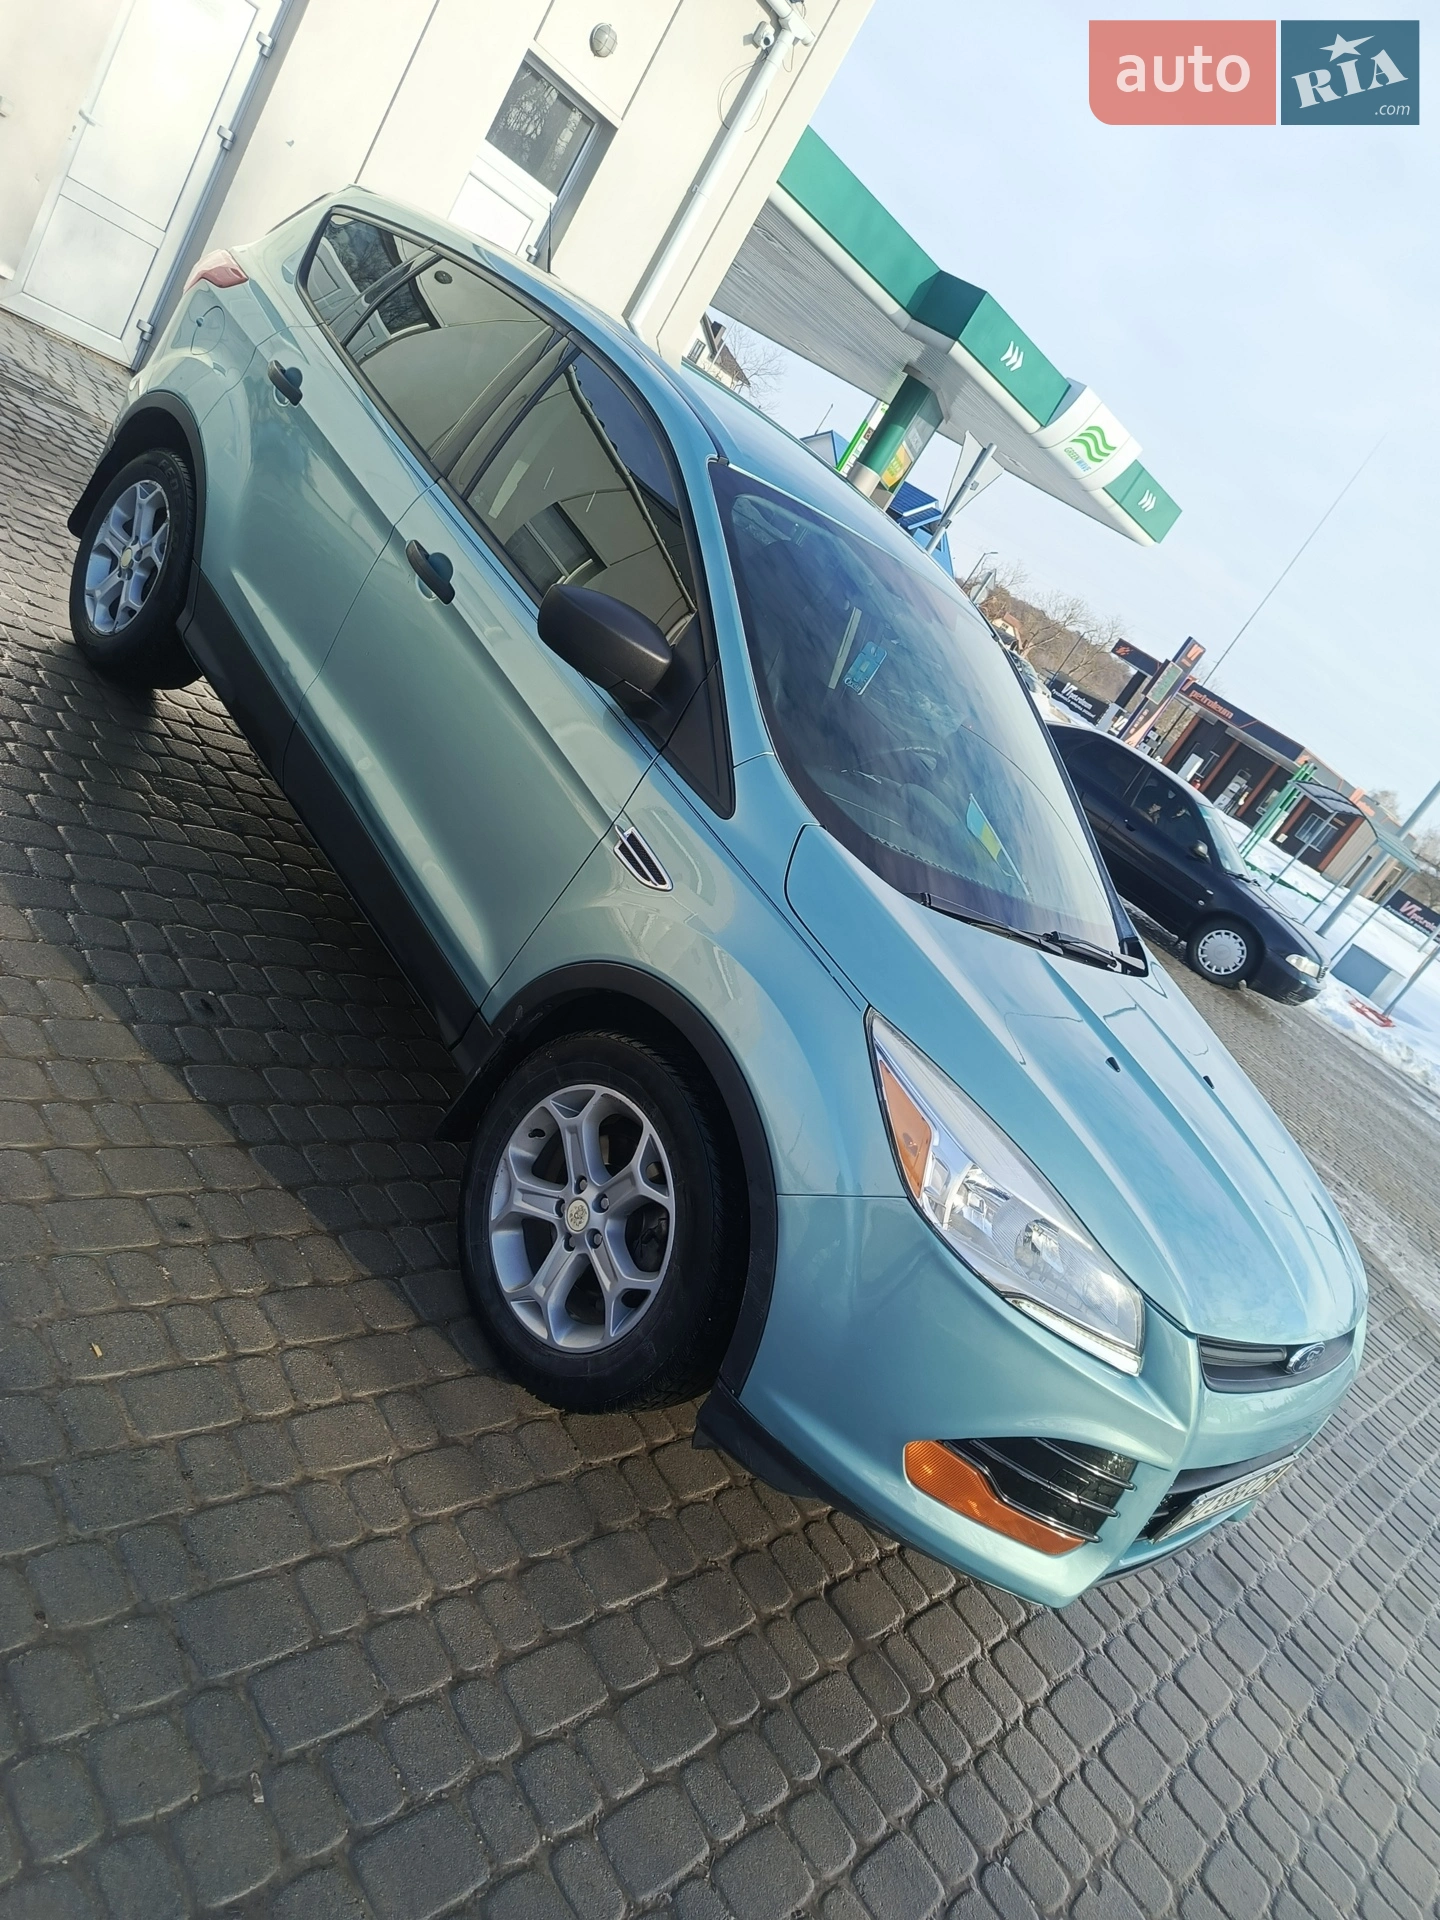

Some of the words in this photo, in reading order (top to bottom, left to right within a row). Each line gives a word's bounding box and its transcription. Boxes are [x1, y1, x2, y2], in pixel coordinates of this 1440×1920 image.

[1063, 447, 1080, 461] GREEN
[1075, 459, 1092, 472] WAVE
[1189, 690, 1234, 719] petroleum
